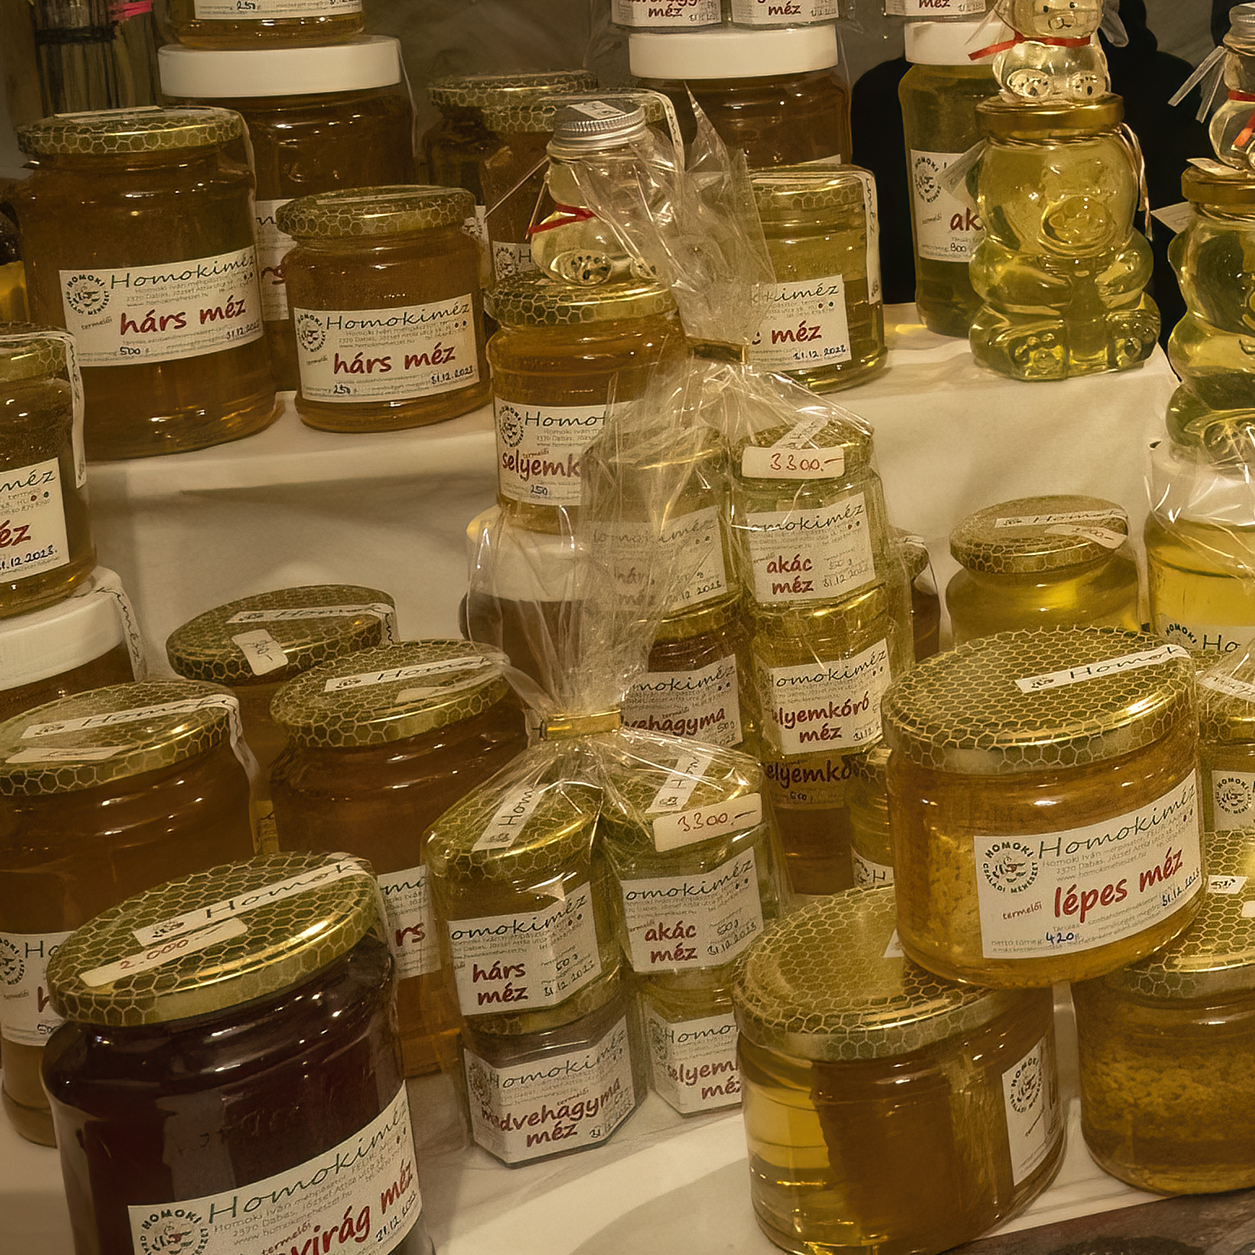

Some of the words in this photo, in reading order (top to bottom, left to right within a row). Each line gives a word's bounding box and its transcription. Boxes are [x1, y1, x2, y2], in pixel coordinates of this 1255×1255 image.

[647, 4, 684, 19] méz
[767, 2, 802, 16] méz
[111, 252, 255, 291] Homokiméz
[120, 309, 187, 336] hárs
[200, 294, 246, 325] méz
[326, 300, 471, 331] Homokiméz
[771, 320, 822, 345] méz
[333, 353, 392, 375] hárs
[404, 341, 457, 371] méz
[501, 450, 582, 483] selyemk
[0, 519, 32, 547] éz
[766, 554, 813, 574] akác
[771, 575, 814, 595] méz
[799, 724, 842, 744] méz
[1038, 783, 1196, 860] Homokiméz
[984, 841, 1035, 859] HOMOKI
[1053, 878, 1129, 925] lépes
[1139, 845, 1185, 893] méz
[1002, 900, 1044, 921] termelői
[644, 921, 697, 943] akác
[1045, 931, 1076, 945] 420
[650, 943, 699, 964] méz
[471, 959, 527, 984] hárs
[476, 985, 529, 1006] méz
[668, 1059, 740, 1087] selyem
[525, 1122, 579, 1147] méz
[380, 1157, 414, 1215] méz
